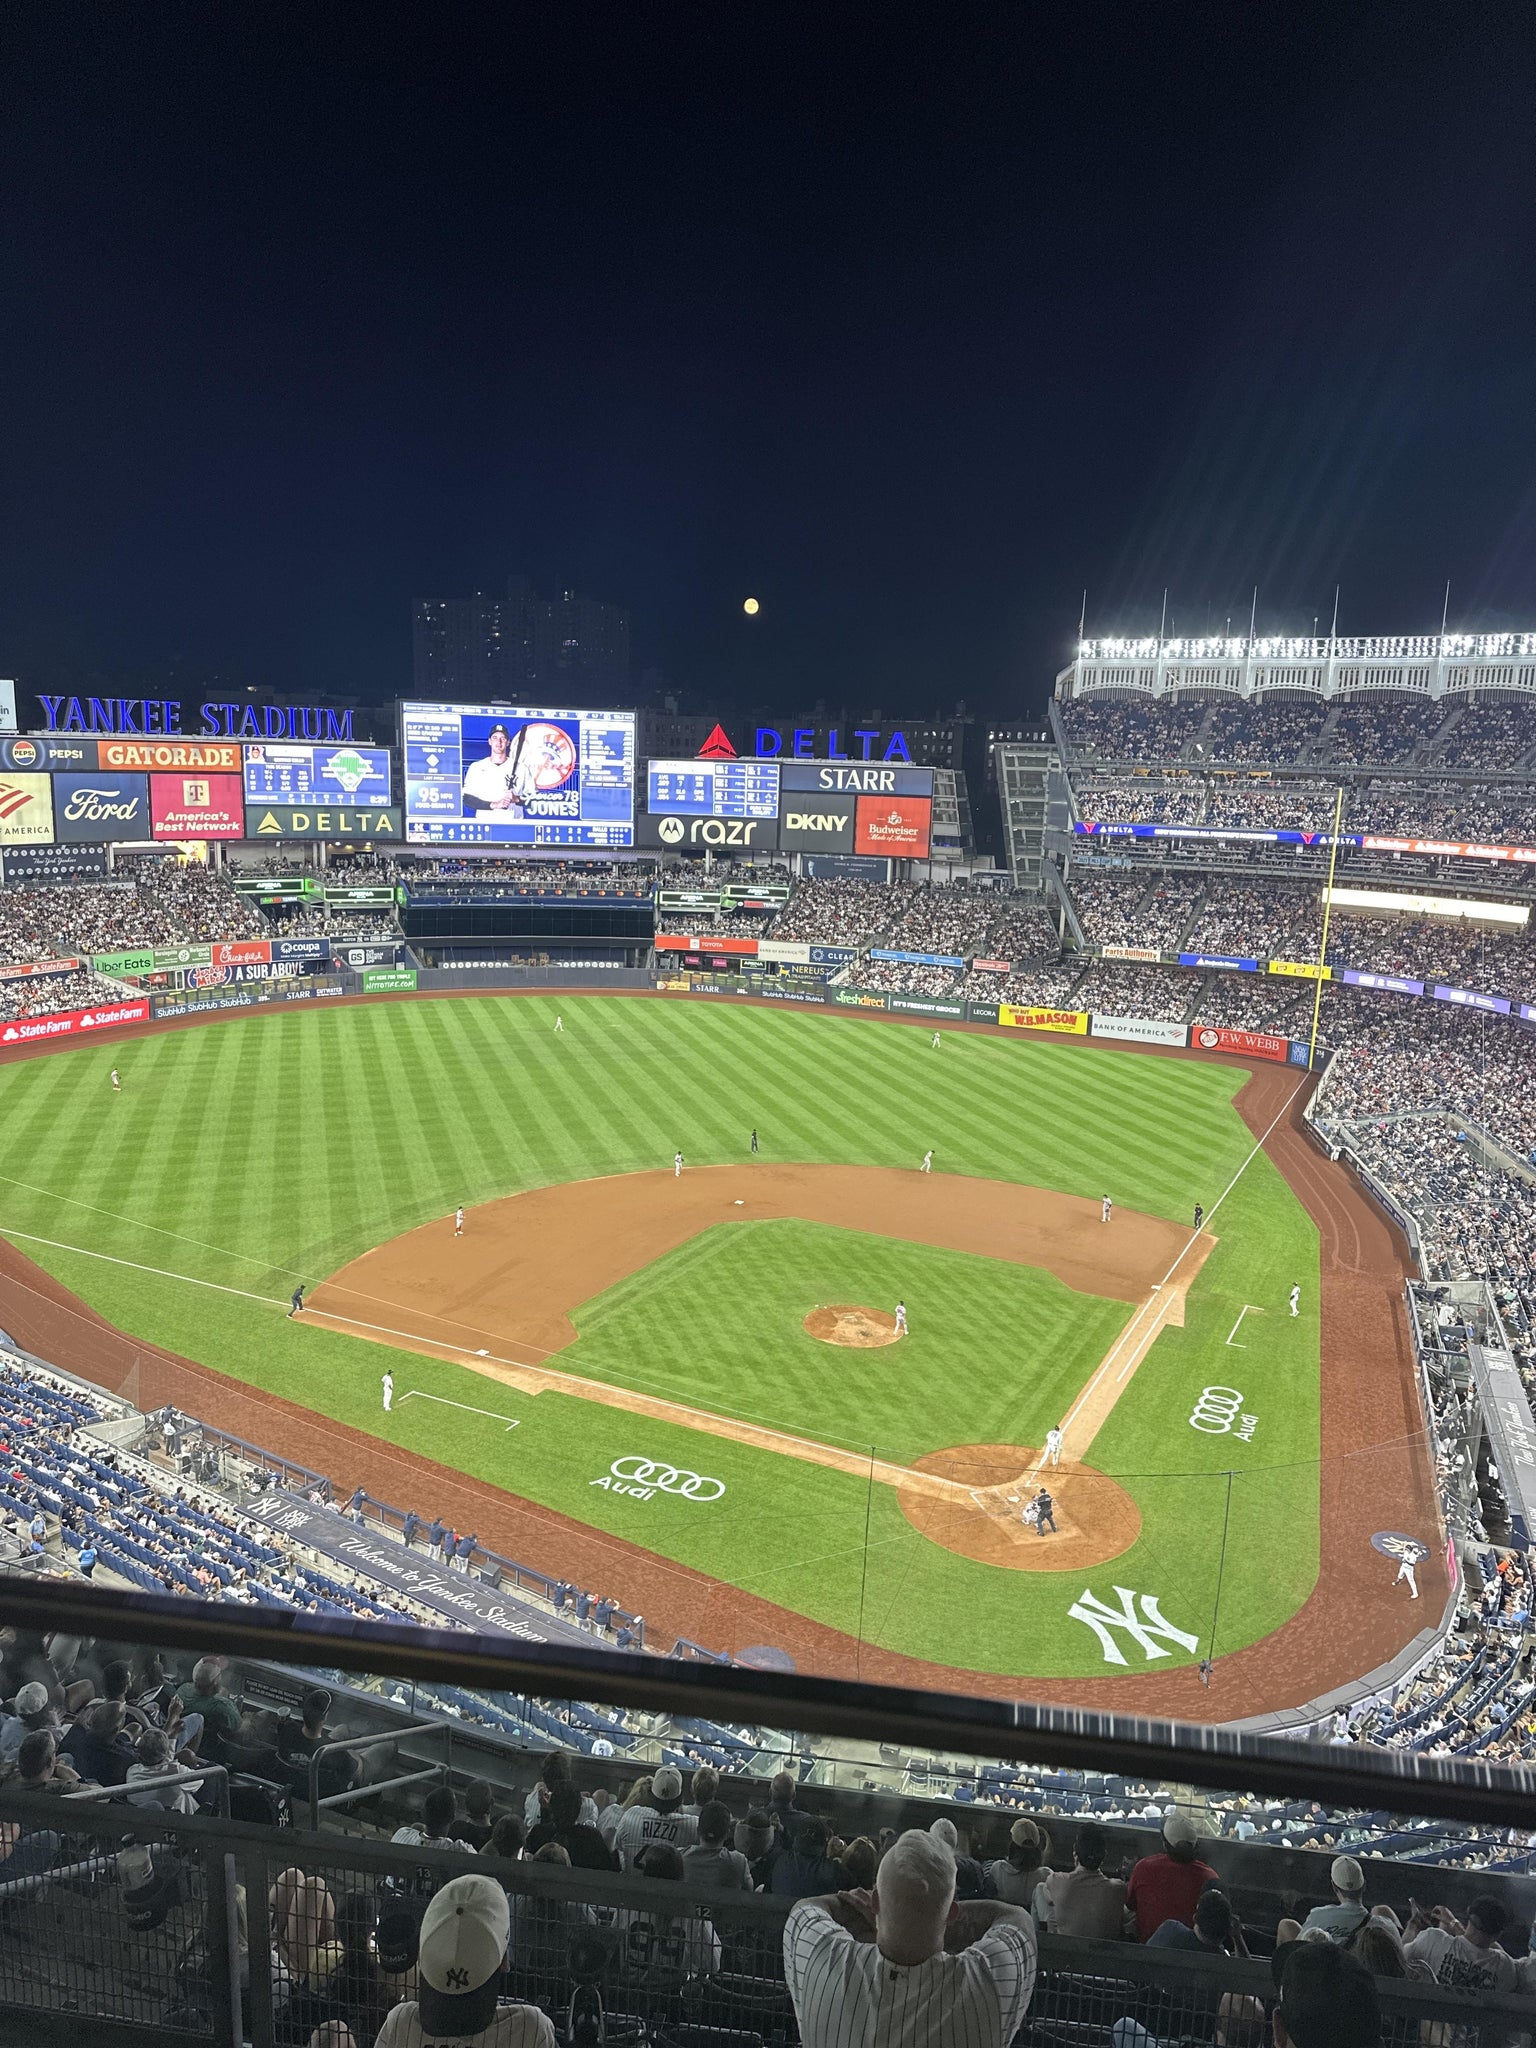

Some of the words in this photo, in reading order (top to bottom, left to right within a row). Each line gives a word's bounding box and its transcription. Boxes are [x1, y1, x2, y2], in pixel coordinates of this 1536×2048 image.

[35, 694, 182, 735] YANKEE
[200, 702, 355, 741] STADIUM
[755, 727, 912, 762] DELTA
[49, 749, 83, 759] PEPSI
[107, 746, 234, 767] GATORADE
[819, 768, 895, 791] STARR
[418, 787, 439, 802] 95
[564, 790, 579, 802] 78
[64, 789, 137, 820] Ford
[526, 801, 579, 817] JONES
[166, 811, 230, 822] America's
[292, 813, 394, 832] DELTA
[786, 813, 848, 831] DKNY
[5, 826, 50, 835] AMERICA
[155, 821, 183, 832] Best
[186, 820, 240, 832] Network
[691, 819, 757, 845] razr
[869, 824, 918, 836] Budweiser
[1108, 826, 1133, 834] DELTA
[292, 942, 320, 953] coupa
[1105, 947, 1123, 955] Parts
[1125, 949, 1157, 959] Authority
[828, 952, 854, 961] CLEAR
[96, 962, 123, 972] Uber
[124, 959, 151, 970] Eats
[236, 966, 243, 981] A
[246, 963, 268, 979] SUB
[271, 961, 305, 977] ABOVE
[791, 965, 825, 975] NEREUS
[316, 987, 343, 996] CUTWATER
[366, 980, 414, 991] NITTOTIRE.COM
[696, 985, 719, 993] STARR
[286, 991, 311, 1000] STARR
[784, 992, 804, 1001] StubHub
[805, 995, 825, 1003] StubHub
[836, 991, 885, 1009] freshdirect
[157, 1006, 186, 1018] StubHub
[188, 1002, 217, 1013] StubHub
[220, 997, 251, 1009] StubHub
[973, 1009, 996, 1017] LEGORA
[1093, 1023, 1115, 1031] BANK
[1129, 1027, 1166, 1037] AMERICA
[1220, 1032, 1242, 1044] F.W.
[1245, 1036, 1280, 1051] WEBB
[1233, 1413, 1259, 1442] Audi
[589, 1476, 656, 1500] Audi
[339, 1538, 402, 1574] Welcome
[401, 1569, 421, 1581] to
[407, 1574, 476, 1611] Yankee
[476, 1606, 548, 1643] Stadium
[608, 1711, 619, 1723] 99
[642, 1820, 678, 1842] RIZZO
[164, 1833, 177, 1842] 14
[416, 1868, 431, 1878] 13
[696, 1906, 711, 1917] 12
